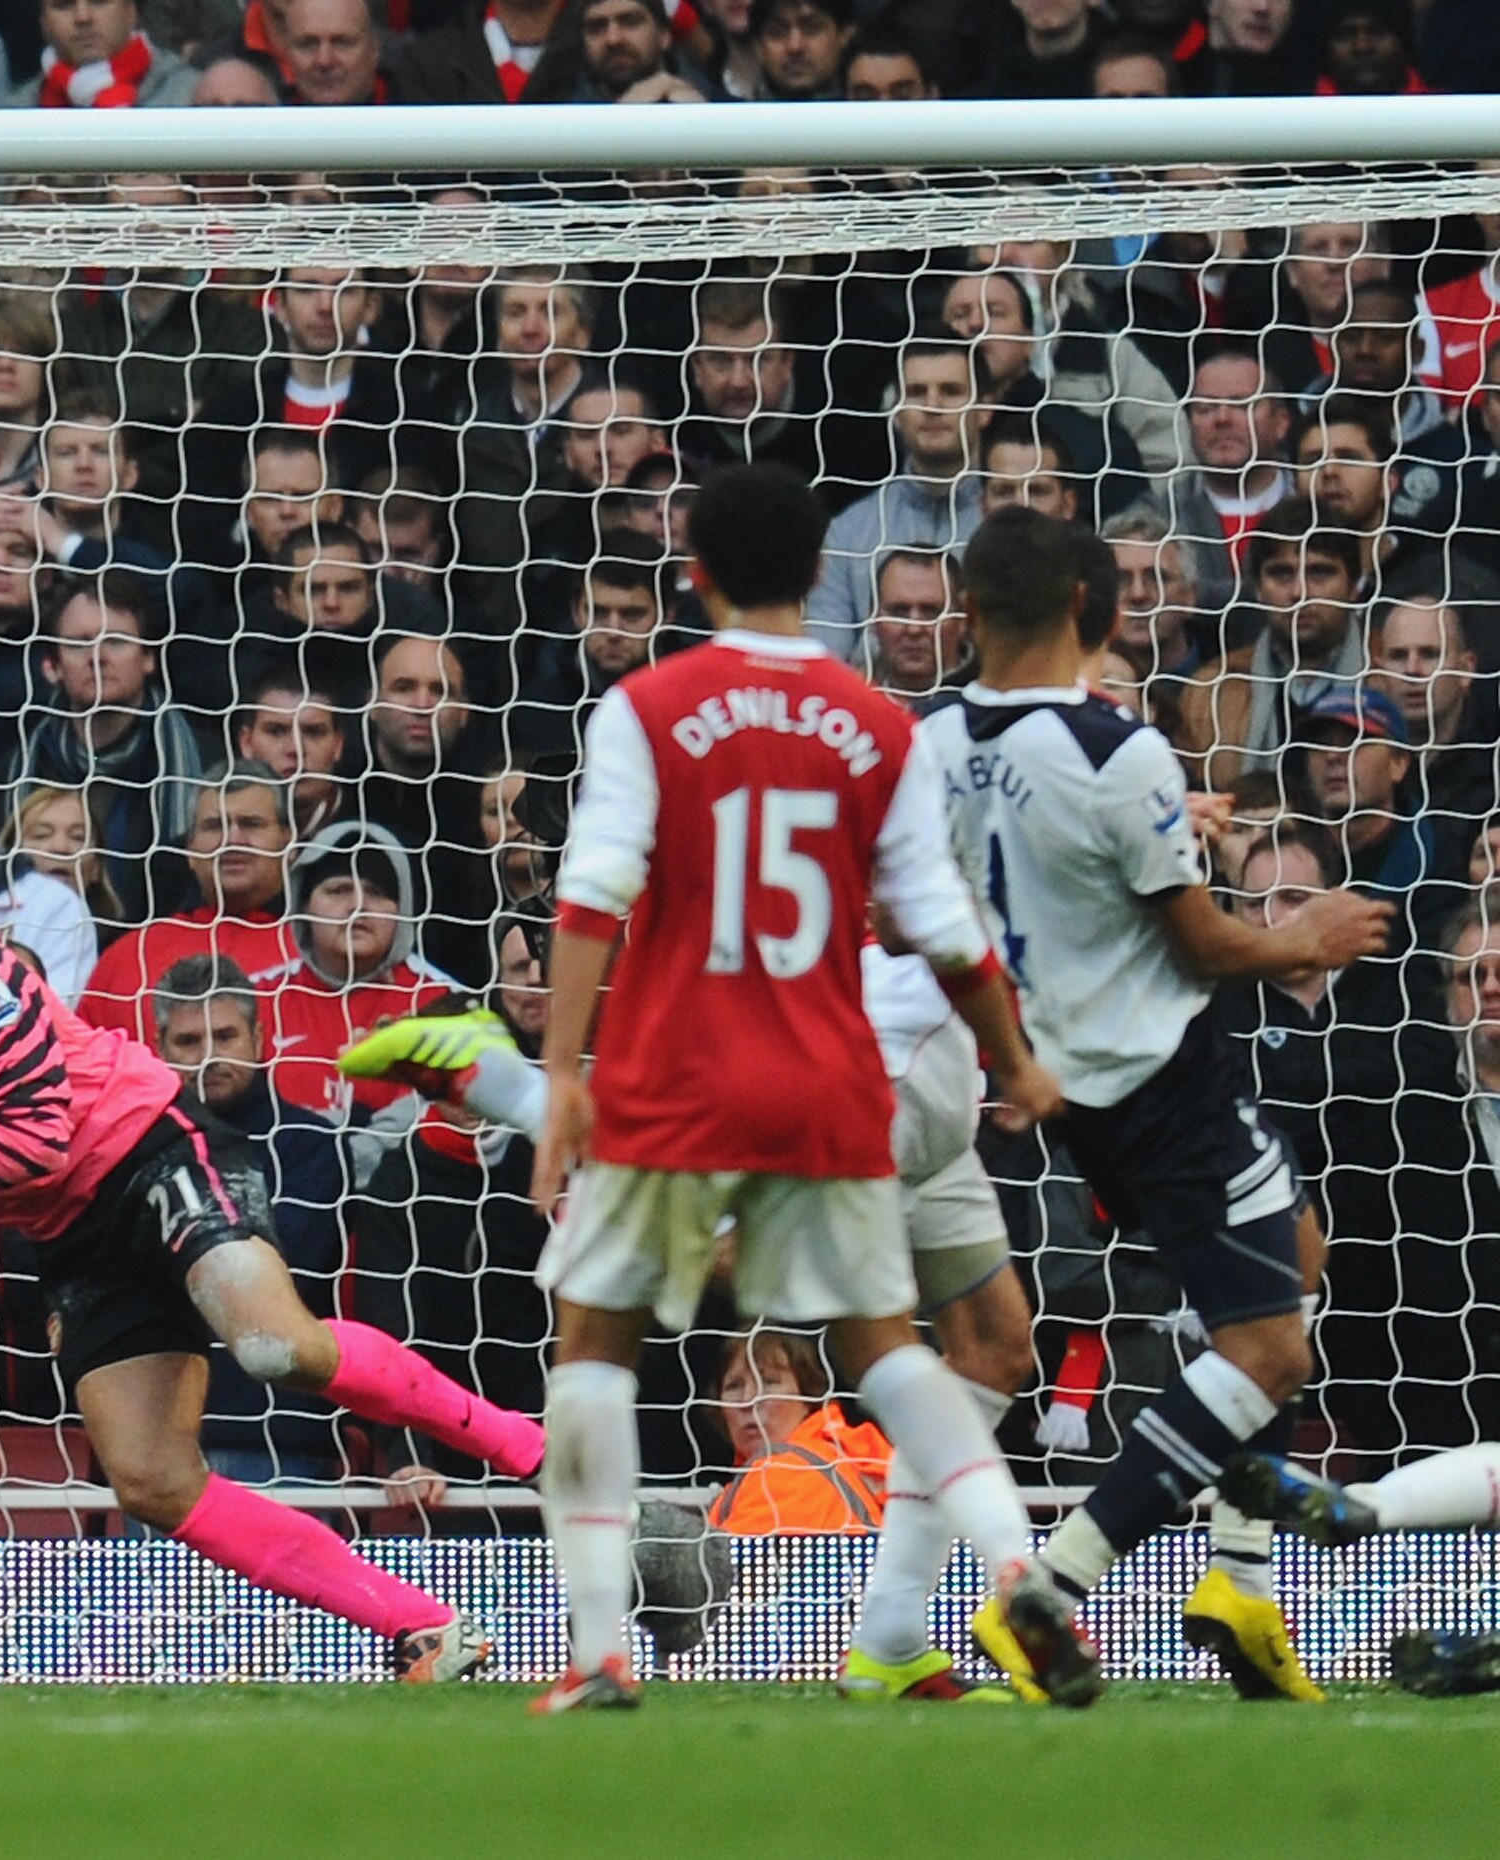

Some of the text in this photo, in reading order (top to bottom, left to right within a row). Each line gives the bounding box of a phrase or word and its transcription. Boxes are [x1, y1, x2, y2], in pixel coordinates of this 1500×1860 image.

[671, 687, 882, 777] DENILSON
[705, 786, 838, 979] 15
[146, 1165, 203, 1244] 21
